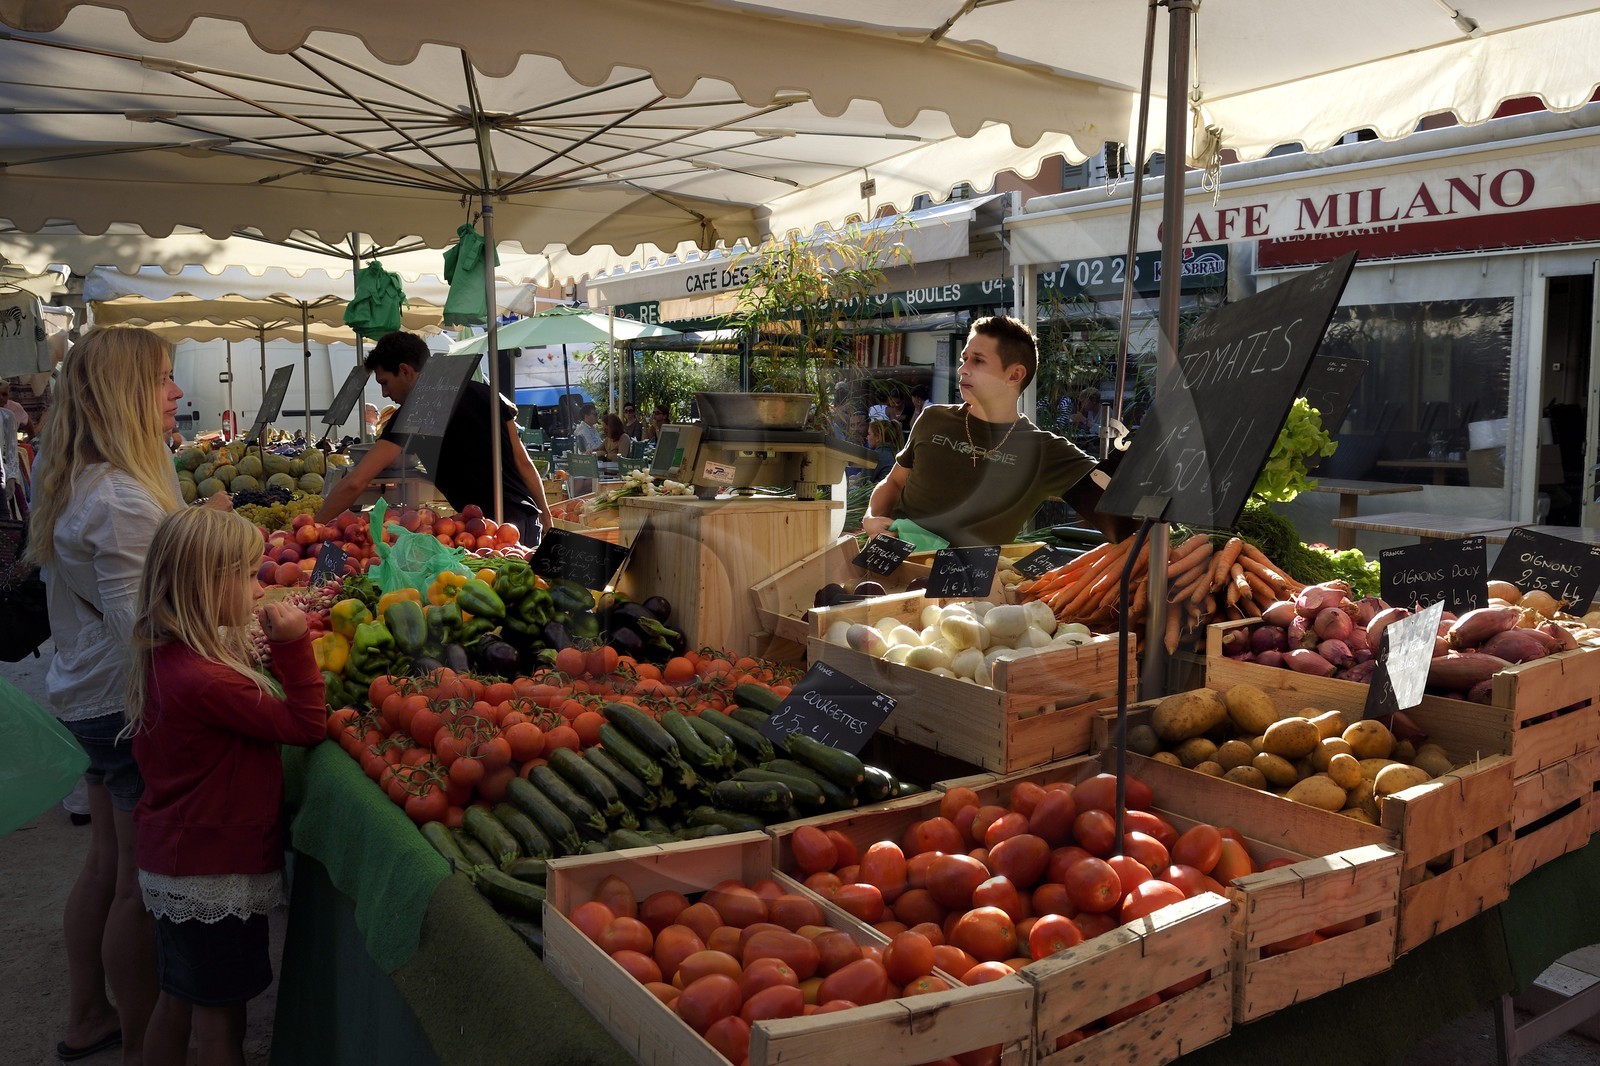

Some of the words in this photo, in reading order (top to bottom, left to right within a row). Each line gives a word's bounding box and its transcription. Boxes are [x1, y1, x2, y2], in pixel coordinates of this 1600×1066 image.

[1294, 168, 1536, 232] MILANO
[686, 267, 718, 293] CAFÉ
[721, 266, 750, 288] DES
[1076, 260, 1104, 287] 02
[906, 284, 961, 304] BOULES
[1173, 318, 1302, 391] TOMATES
[803, 690, 868, 734] COURGETTES
